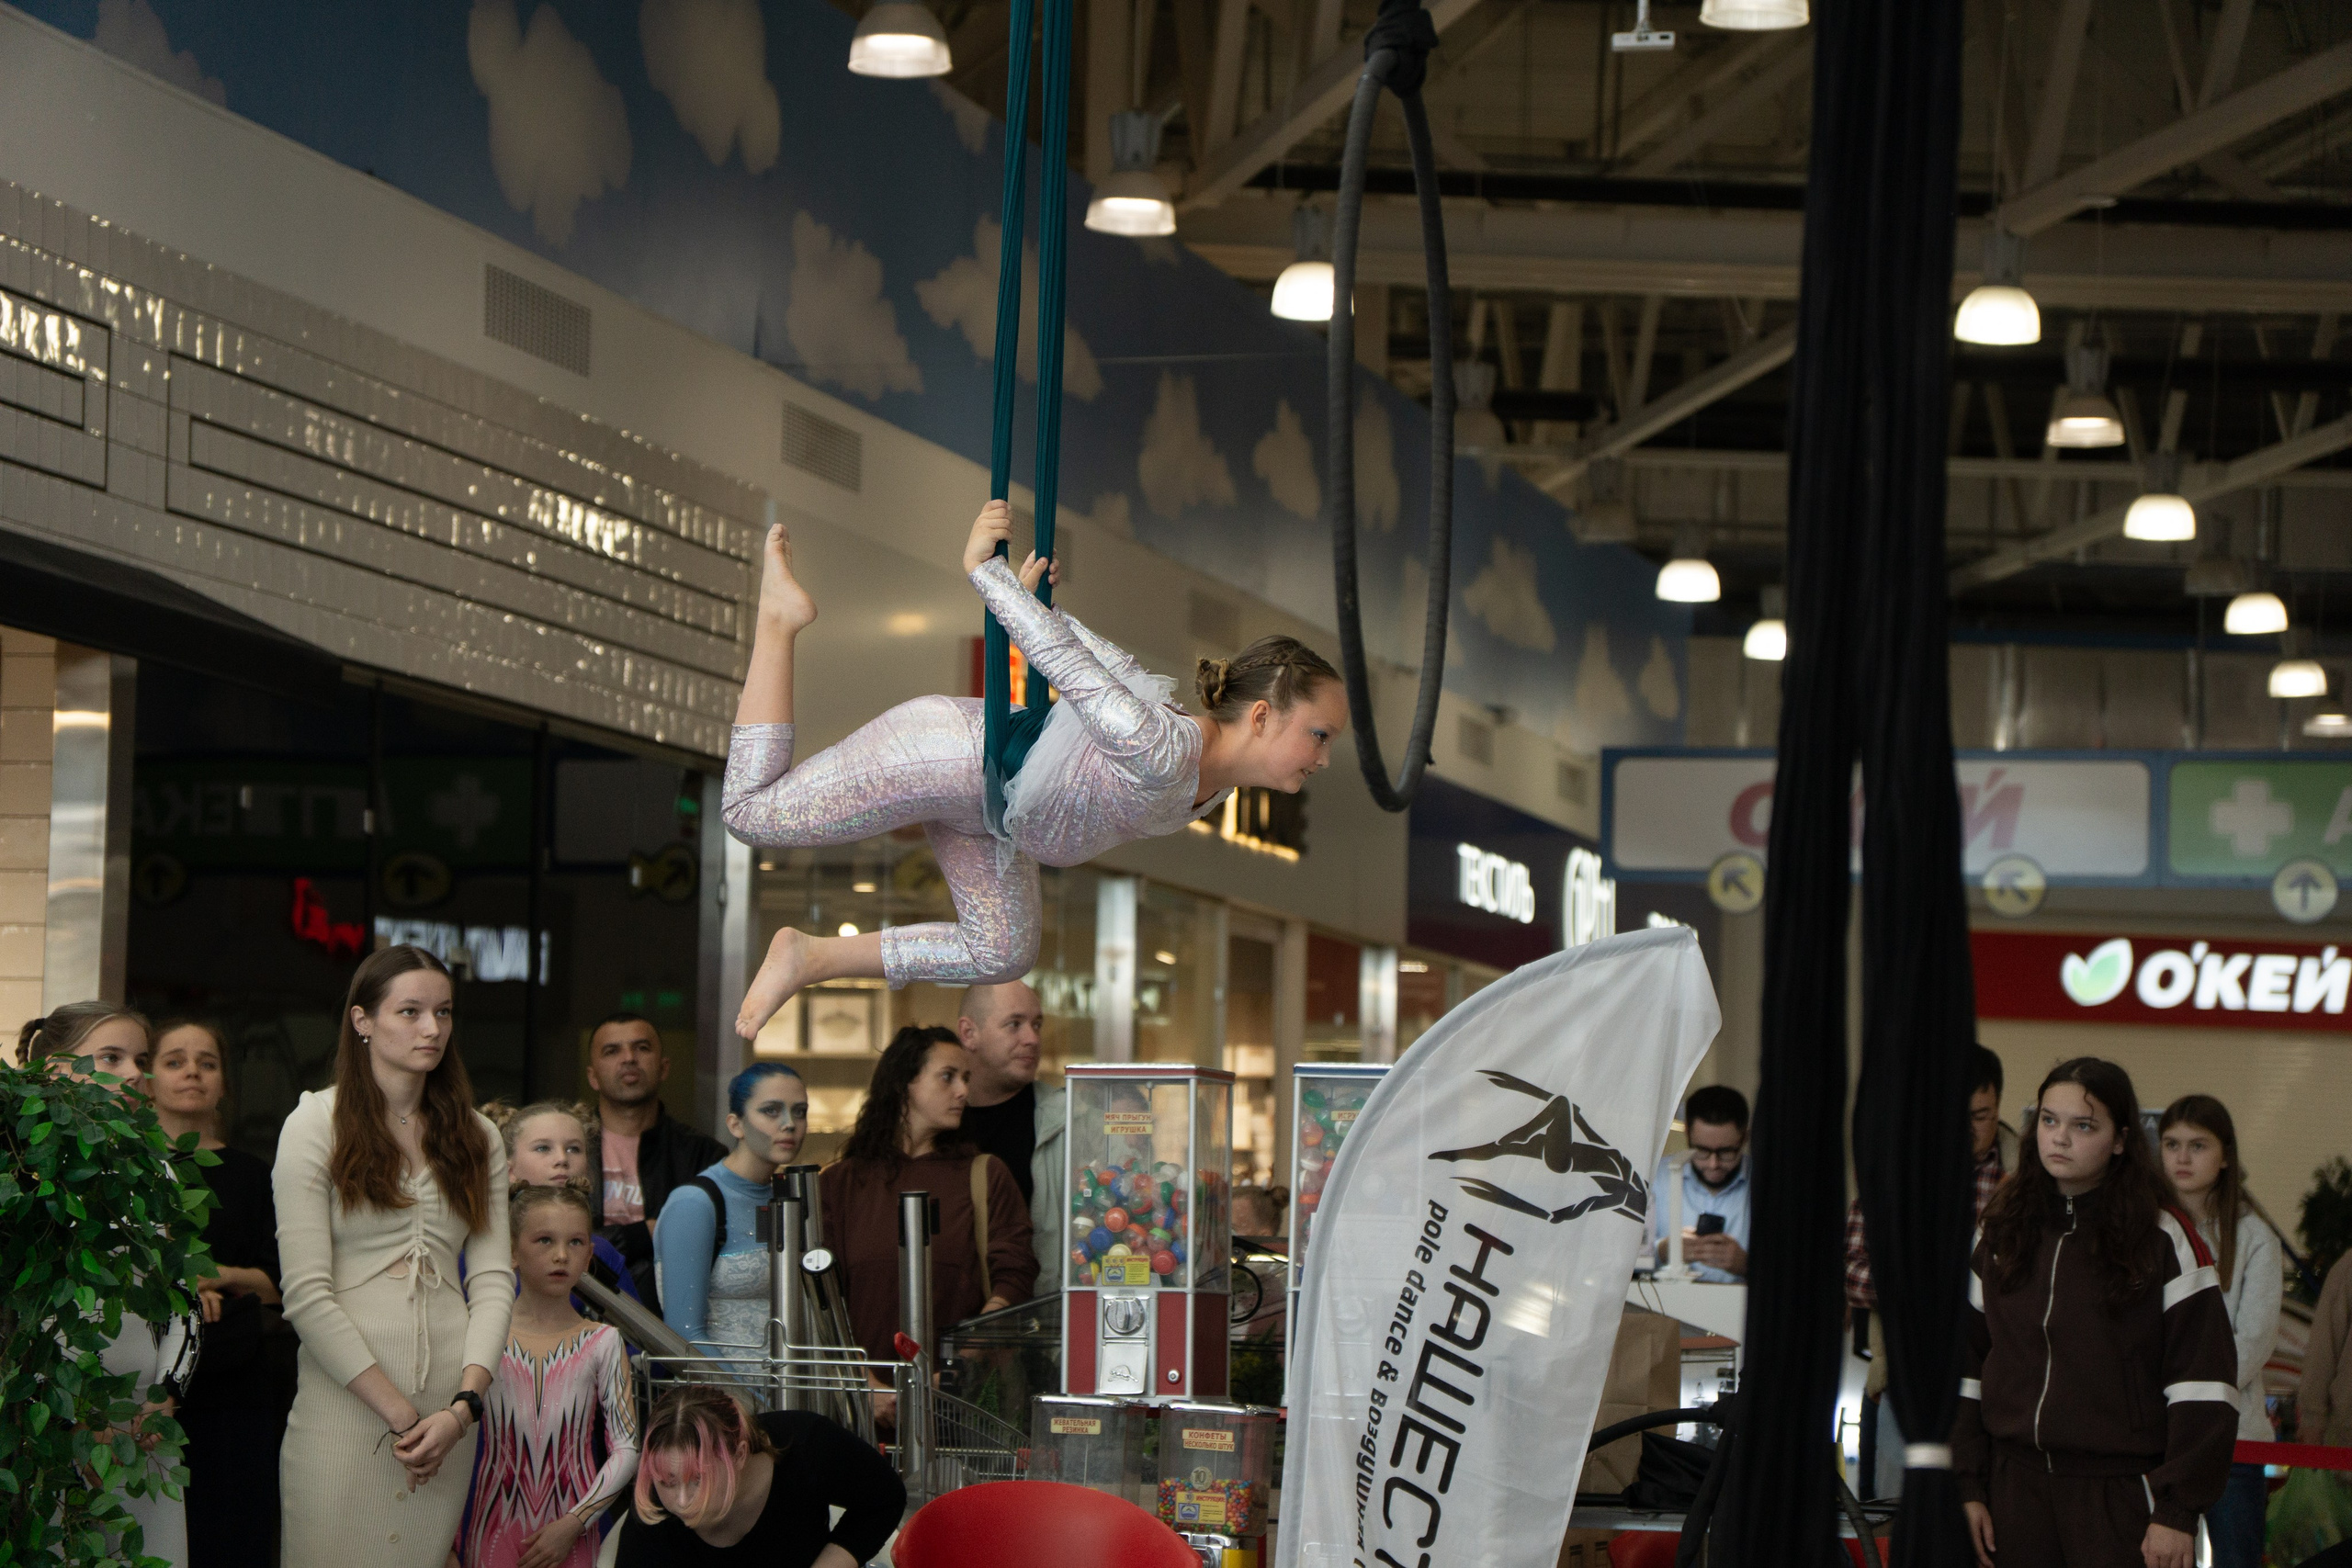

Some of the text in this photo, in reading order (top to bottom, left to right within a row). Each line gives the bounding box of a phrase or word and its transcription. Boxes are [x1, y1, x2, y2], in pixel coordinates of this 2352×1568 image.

[2136, 941, 2352, 1014] О'КЕЙ
[1414, 1199, 1449, 1264] pole
[1385, 1269, 1427, 1356] dance
[1376, 1359, 1399, 1382] &
[1184, 1440, 1217, 1450] НЕСКОЛЬКО
[1188, 1431, 1227, 1440] КОНФЕТЫ
